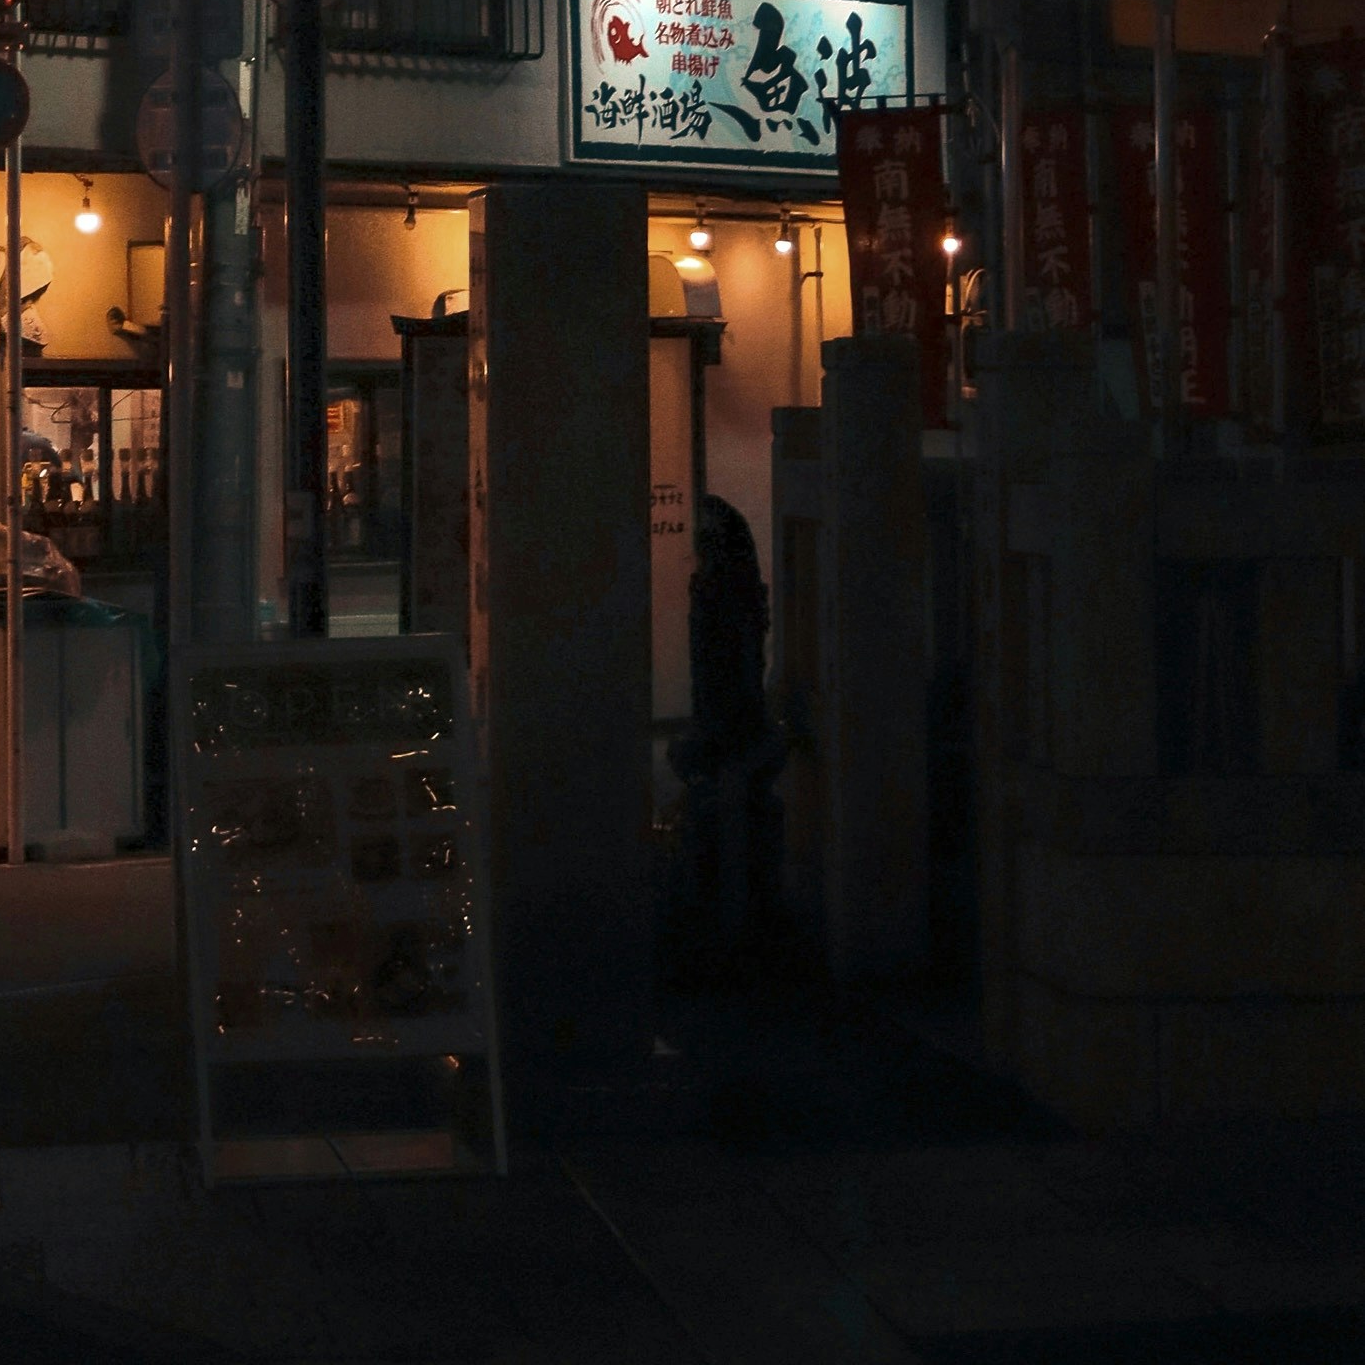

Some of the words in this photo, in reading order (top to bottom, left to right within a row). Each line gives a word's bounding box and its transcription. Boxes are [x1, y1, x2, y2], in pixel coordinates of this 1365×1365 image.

[654, 21, 735, 50] 名物煮込み
[671, 51, 720, 79] 串揚げ
[711, 2, 877, 146] 魚波
[585, 74, 714, 146] 海鮮酒場
